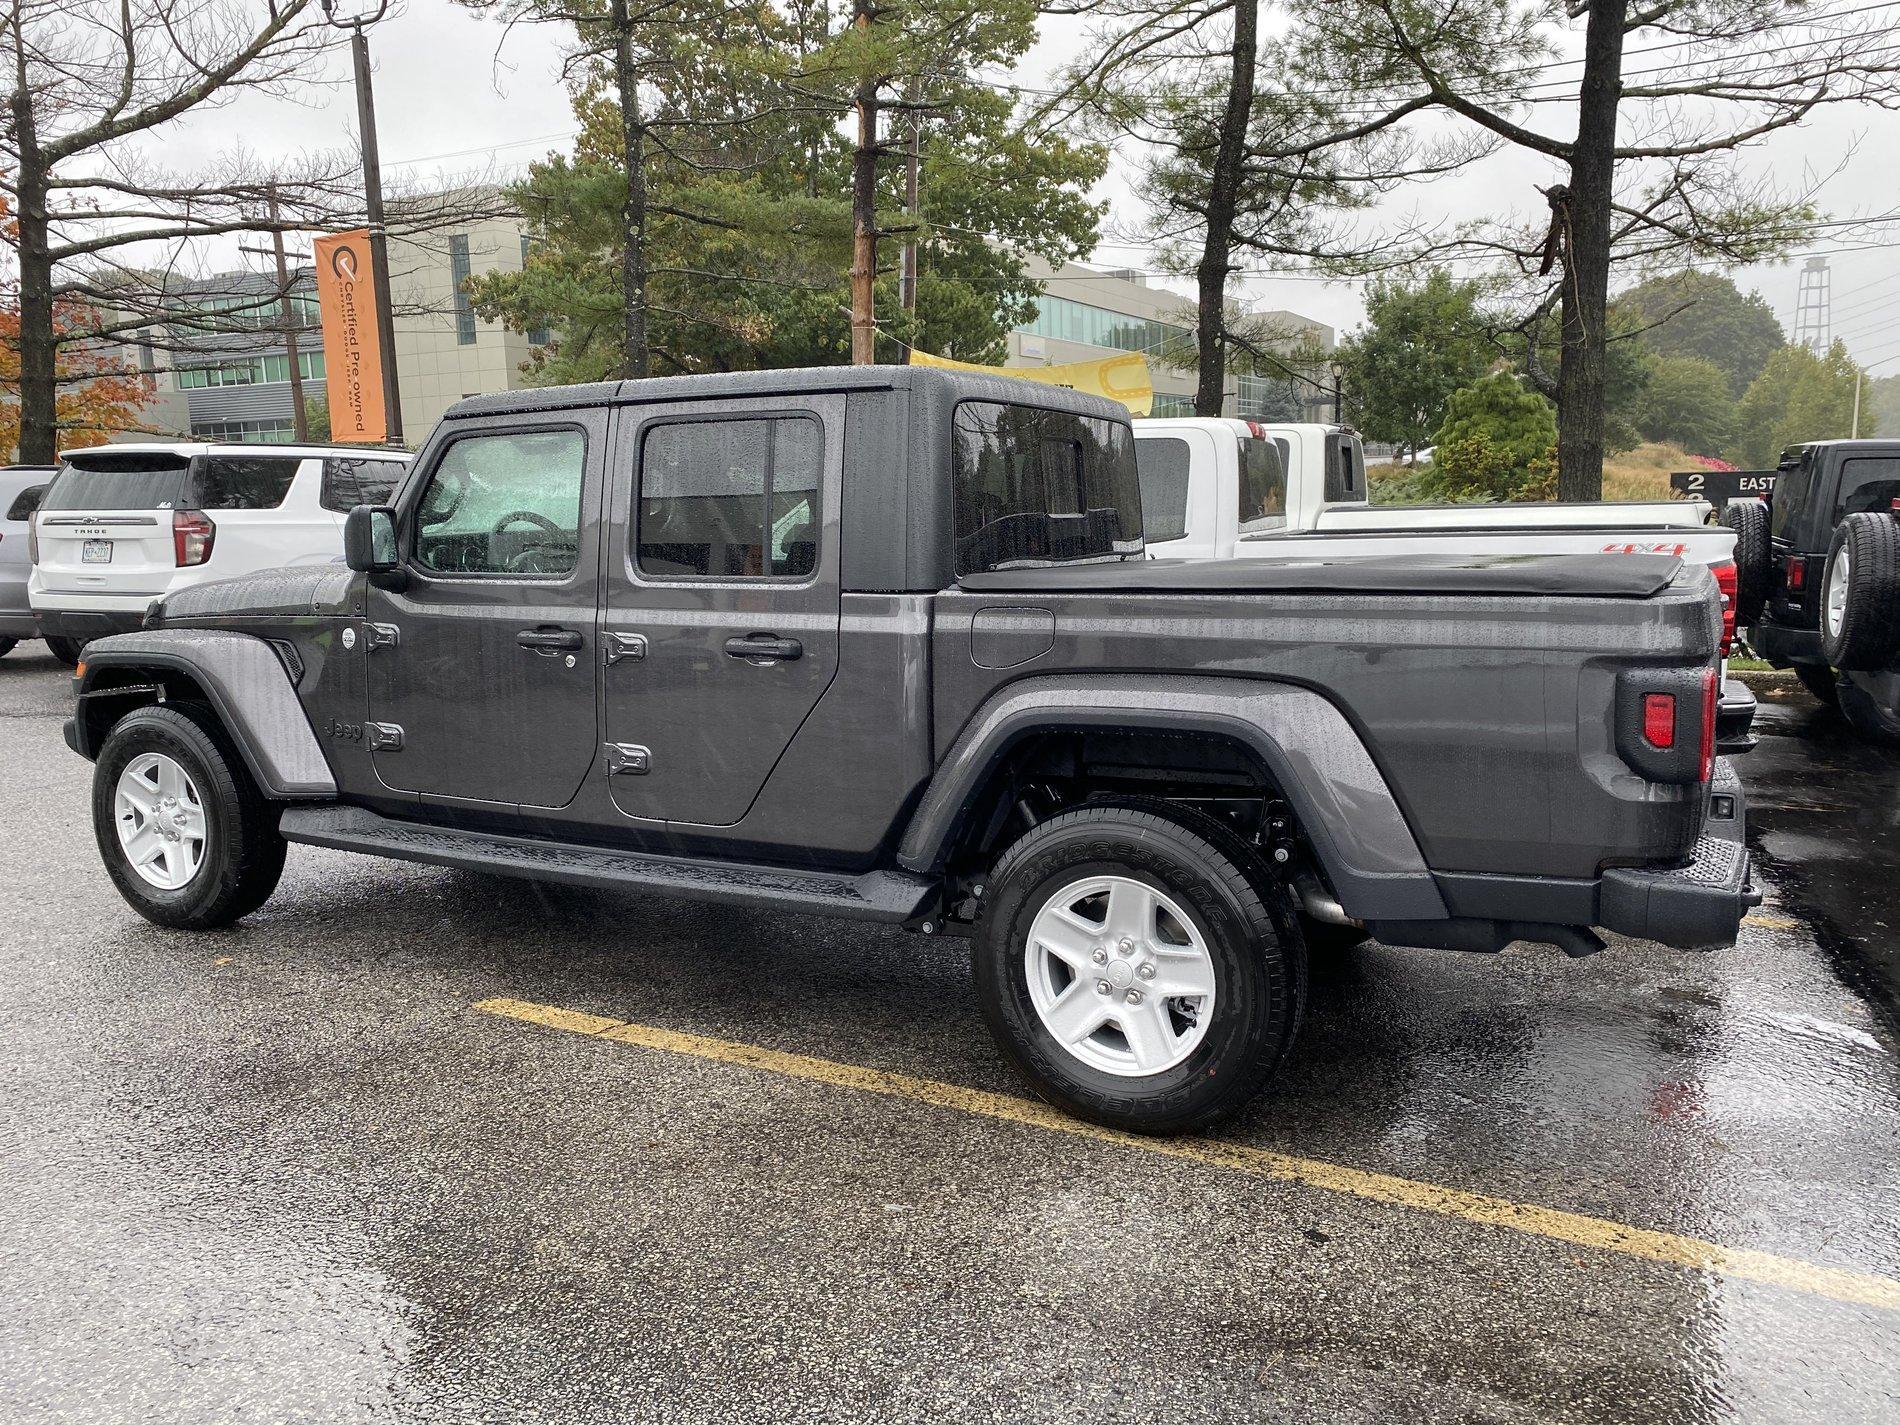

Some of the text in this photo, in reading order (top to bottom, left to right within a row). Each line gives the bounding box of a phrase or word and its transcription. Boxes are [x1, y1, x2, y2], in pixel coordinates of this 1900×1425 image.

[345, 281, 365, 432] Certified Pre-owned
[1688, 474, 1777, 490] 2 EAST
[324, 717, 364, 744] Jeep
[1018, 840, 1230, 923] BRIDGESTONE
